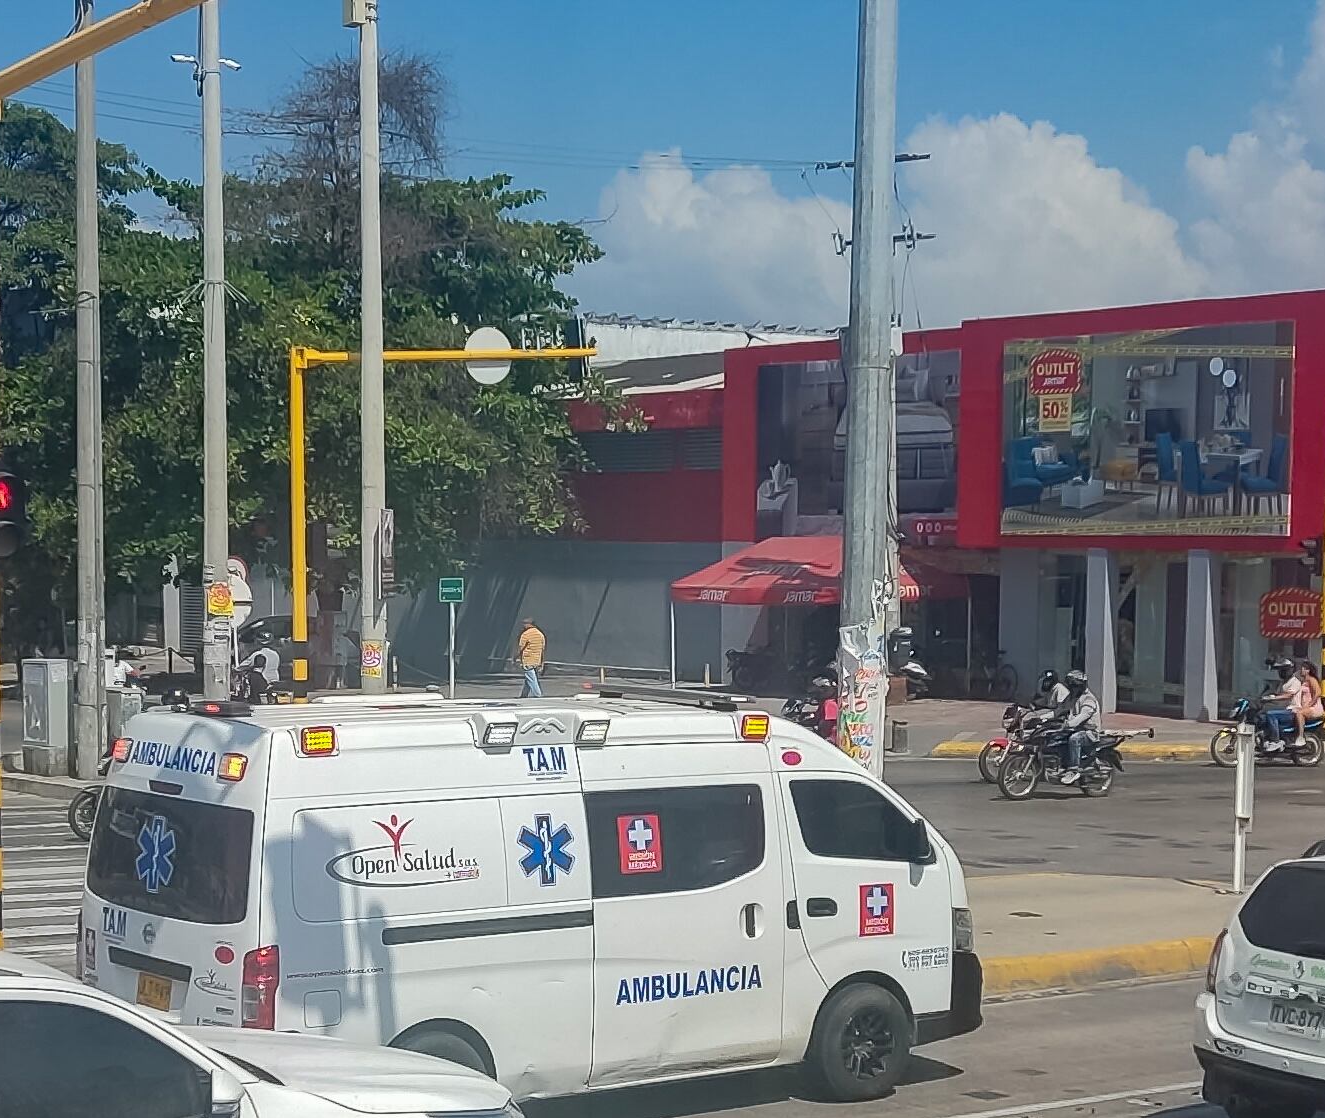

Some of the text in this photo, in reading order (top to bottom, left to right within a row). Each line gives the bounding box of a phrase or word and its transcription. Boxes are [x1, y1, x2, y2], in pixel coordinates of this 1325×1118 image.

[1036, 361, 1075, 376] OUTLET
[1042, 400, 1069, 419] 50%
[1268, 602, 1317, 616] OUTLET
[130, 740, 217, 776] AMBULANCIA
[352, 855, 397, 879] Open
[403, 847, 457, 872] Salud
[616, 965, 763, 1006] AMBULANCIA
